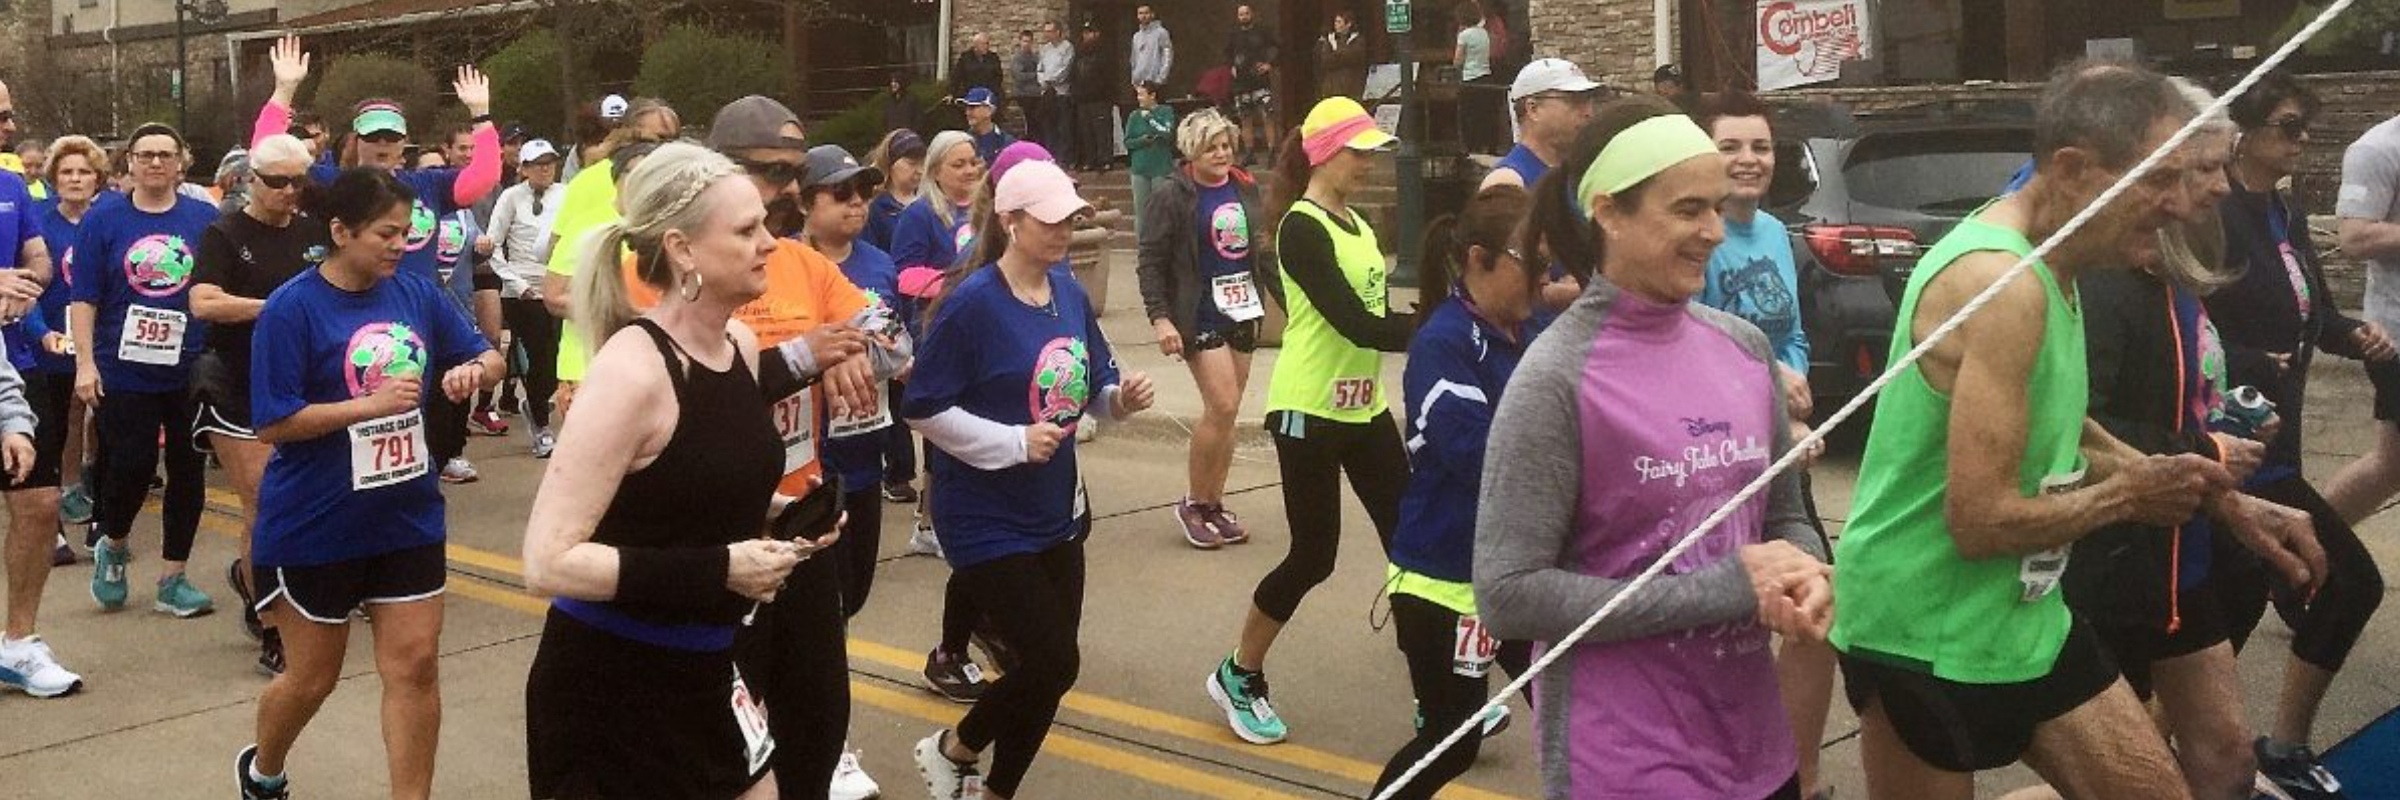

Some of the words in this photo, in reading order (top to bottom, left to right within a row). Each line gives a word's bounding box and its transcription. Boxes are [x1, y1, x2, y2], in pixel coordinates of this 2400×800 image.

[1223, 283, 1249, 306] 553
[136, 319, 170, 342] 593
[1336, 378, 1373, 408] 578
[1680, 417, 1731, 437] Disney
[371, 431, 416, 471] 791
[1634, 456, 1689, 488] Fairy
[1684, 443, 1720, 475] Tale
